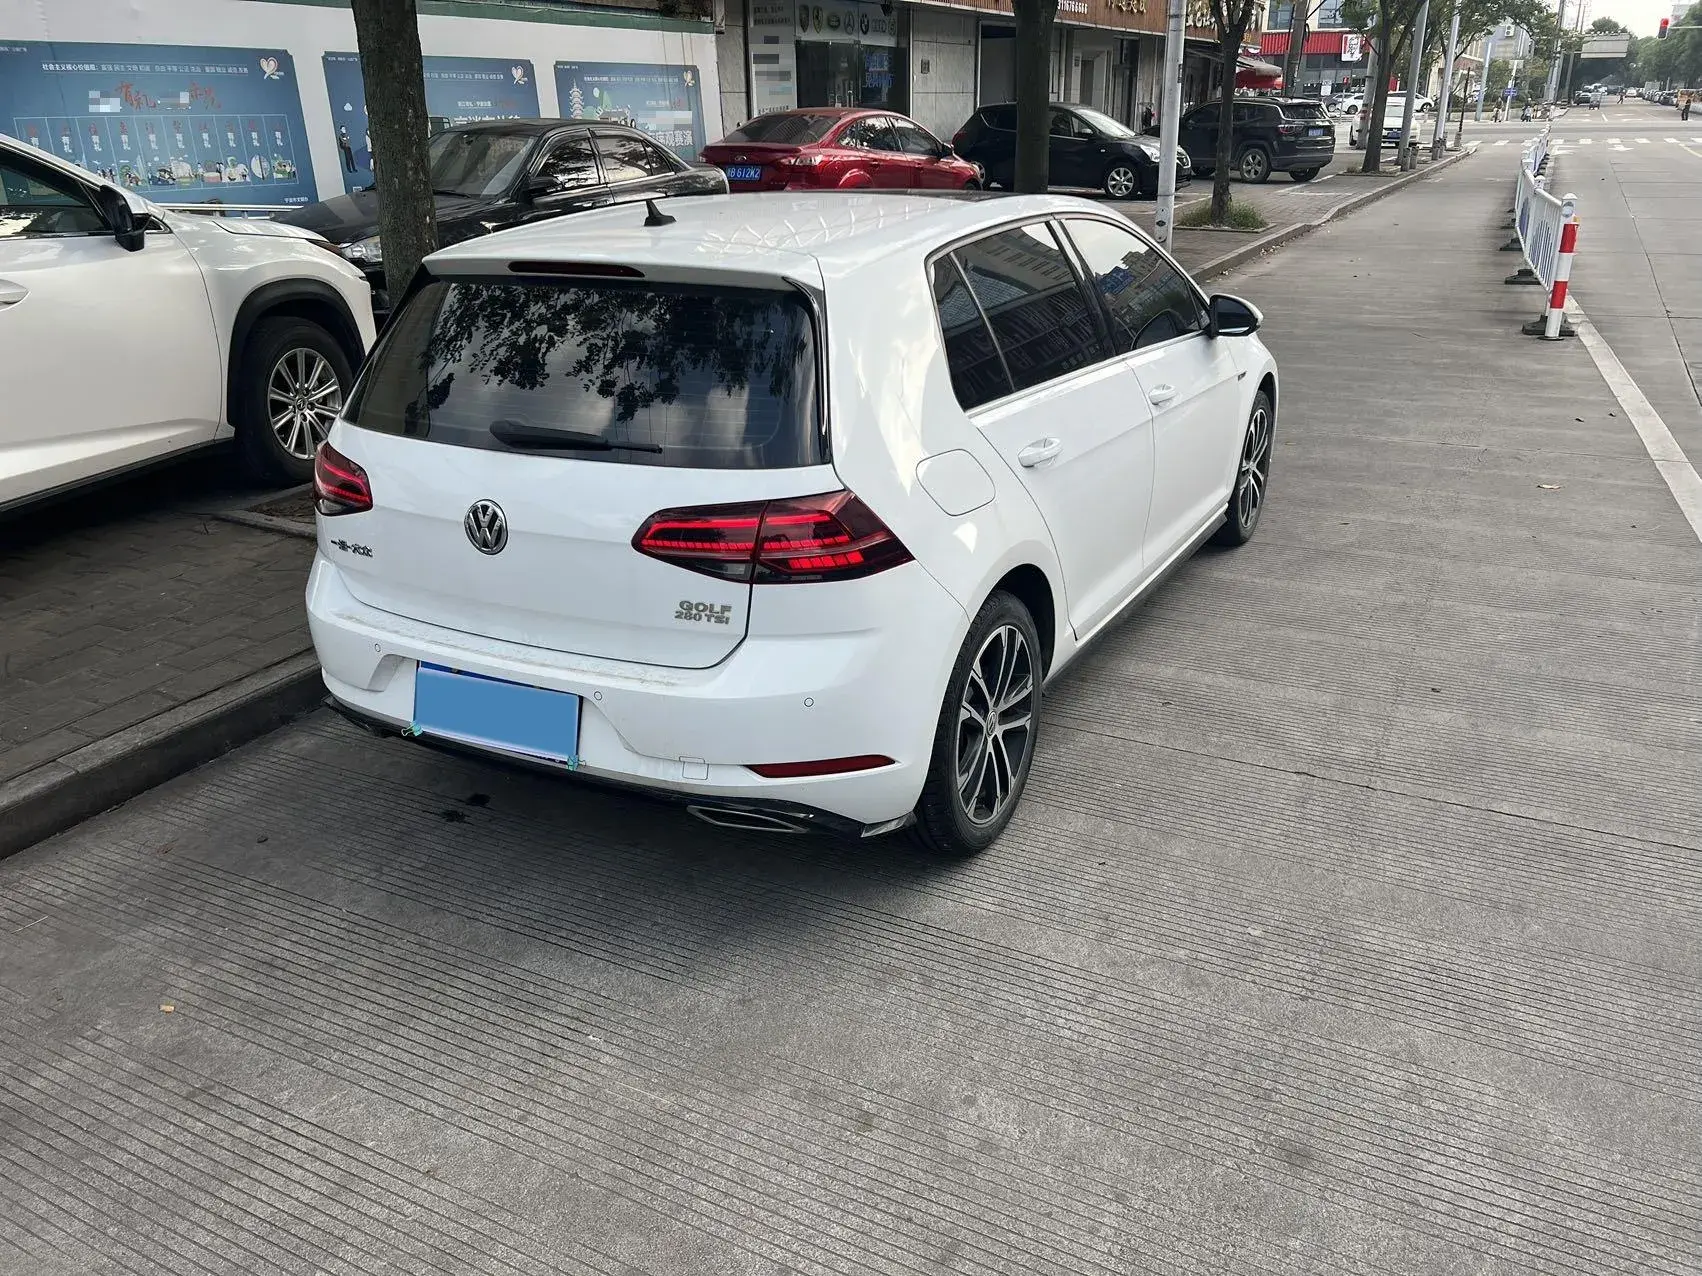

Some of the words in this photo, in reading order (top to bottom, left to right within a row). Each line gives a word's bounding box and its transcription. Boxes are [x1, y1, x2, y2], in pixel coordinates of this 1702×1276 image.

[679, 600, 732, 615] GOLF
[674, 610, 702, 622] 280
[704, 613, 731, 625] TSI
